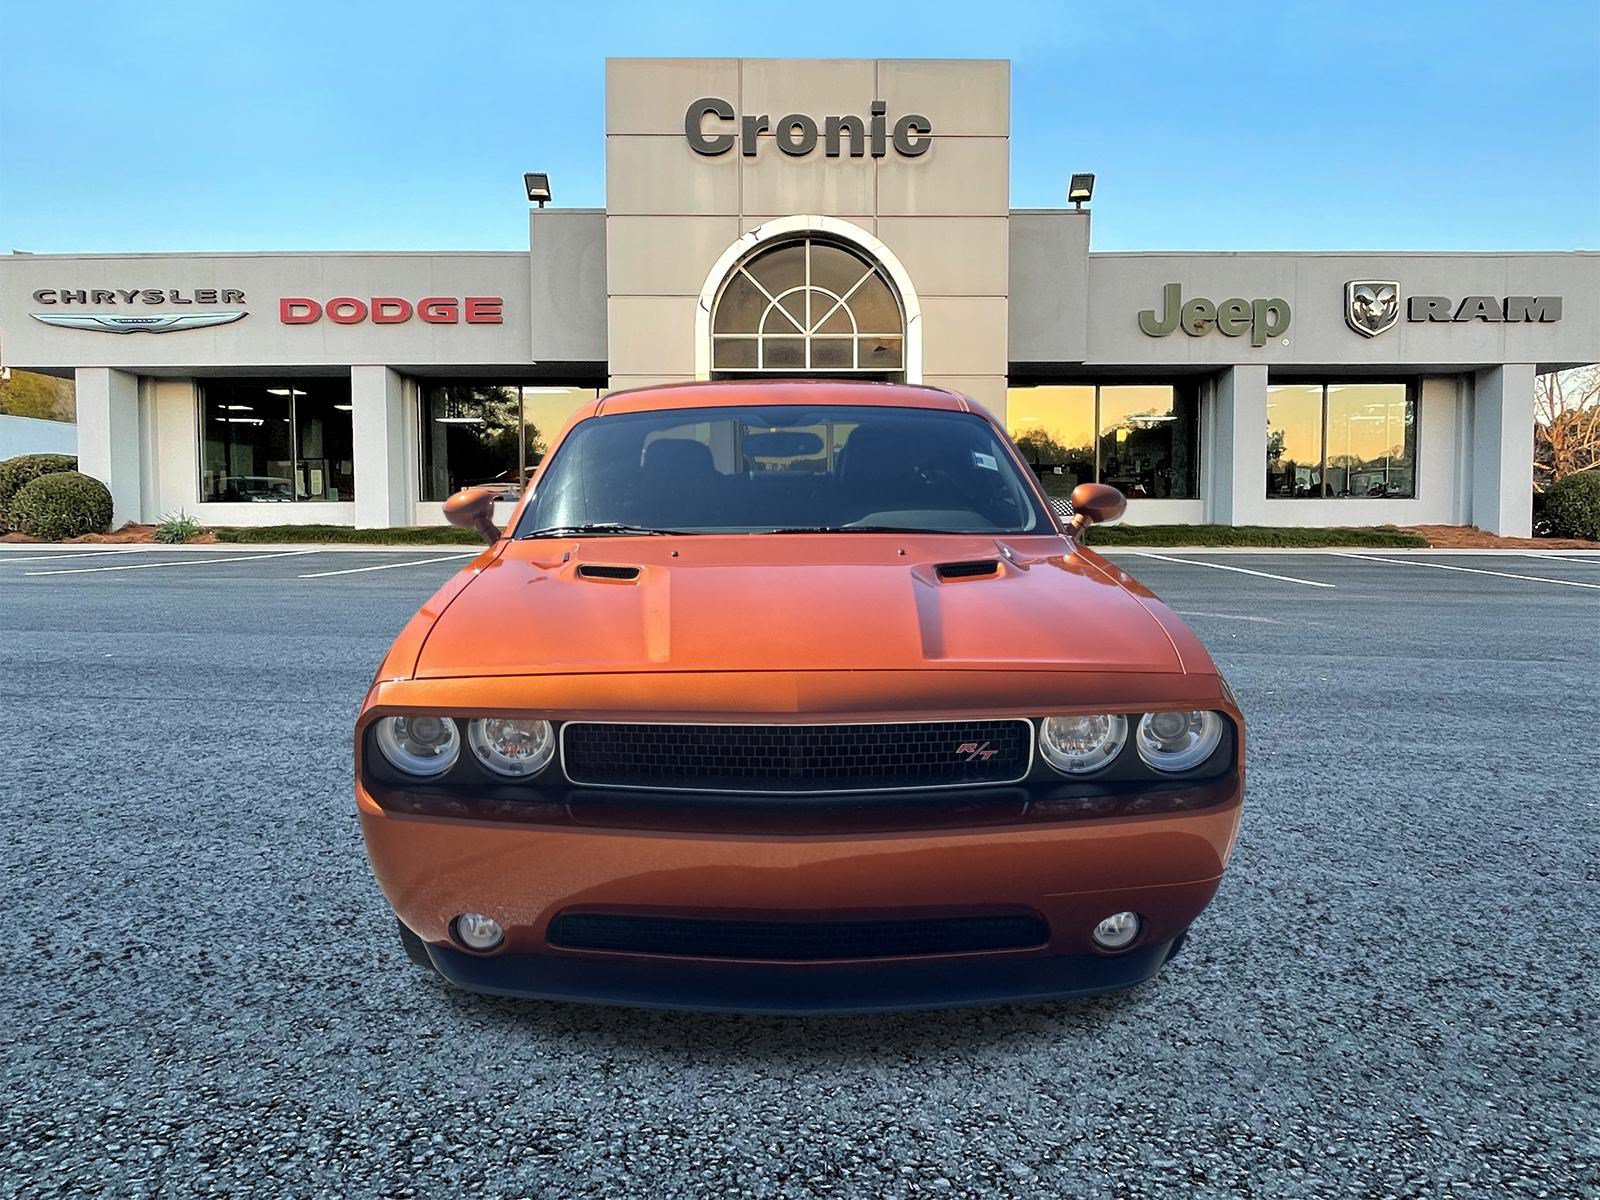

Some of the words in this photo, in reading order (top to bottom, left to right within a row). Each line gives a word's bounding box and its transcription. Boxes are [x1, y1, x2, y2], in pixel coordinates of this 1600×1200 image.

[685, 97, 932, 157] Cronic
[33, 289, 246, 305] CHRYSLER
[280, 297, 503, 324] DODGE
[1408, 295, 1562, 322] RAM
[1139, 283, 1291, 347] Jeep
[956, 741, 999, 761] R/T
